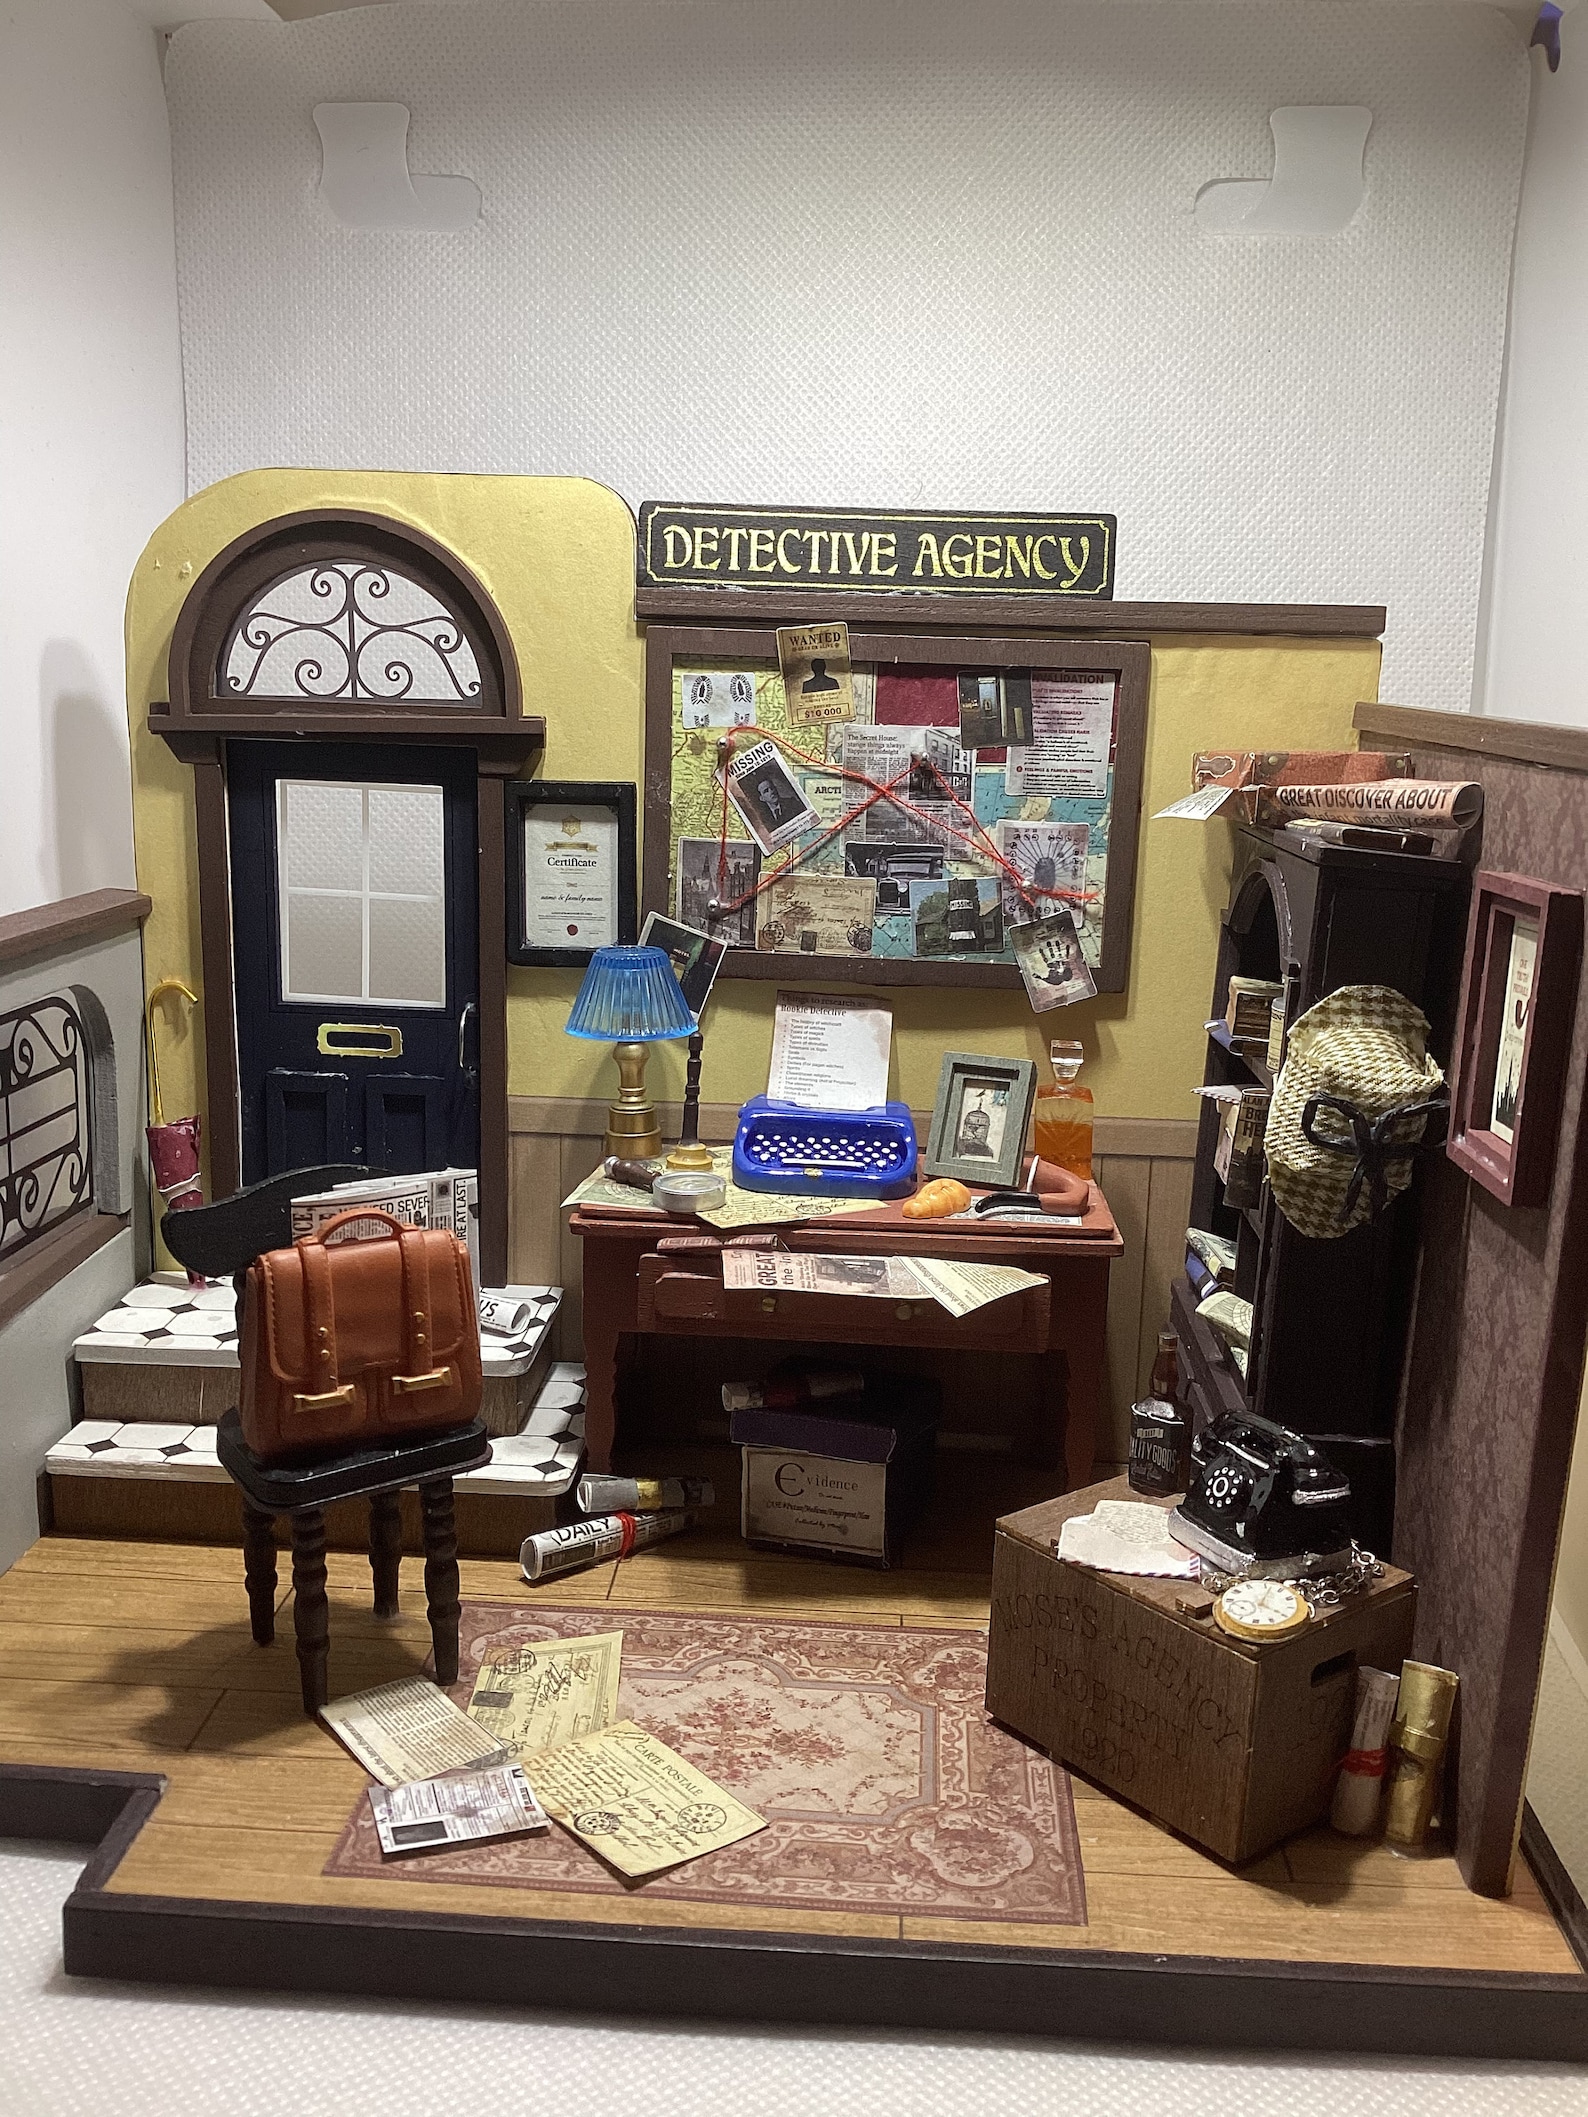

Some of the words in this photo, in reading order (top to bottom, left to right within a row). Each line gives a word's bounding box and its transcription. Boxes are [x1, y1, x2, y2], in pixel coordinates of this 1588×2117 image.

[662, 525, 898, 578] DETECTIVE
[911, 532, 1090, 588] AGENCY
[789, 632, 841, 646] WANTED
[805, 709, 821, 718] $10
[824, 707, 842, 716] 000
[727, 741, 773, 778] MISSING
[1280, 788, 1322, 807] GREAT
[1325, 788, 1395, 809] DISCOVER
[1396, 788, 1453, 810] ABOUT
[547, 857, 597, 868] Certificate
[780, 1004, 808, 1014] Rookie
[810, 1007, 847, 1017] Detective
[457, 1180, 467, 1208] LAST.
[457, 1210, 467, 1223] AT
[755, 1253, 778, 1286] GREAT
[781, 1268, 794, 1285] the
[1152, 1444, 1177, 1474] GOODS
[775, 1463, 858, 1497] Evidence
[555, 1518, 610, 1541] DAILY
[1112, 1619, 1243, 1748] AGENCY
[634, 1744, 664, 1766] CARTE
[662, 1765, 703, 1796] POSTALE
